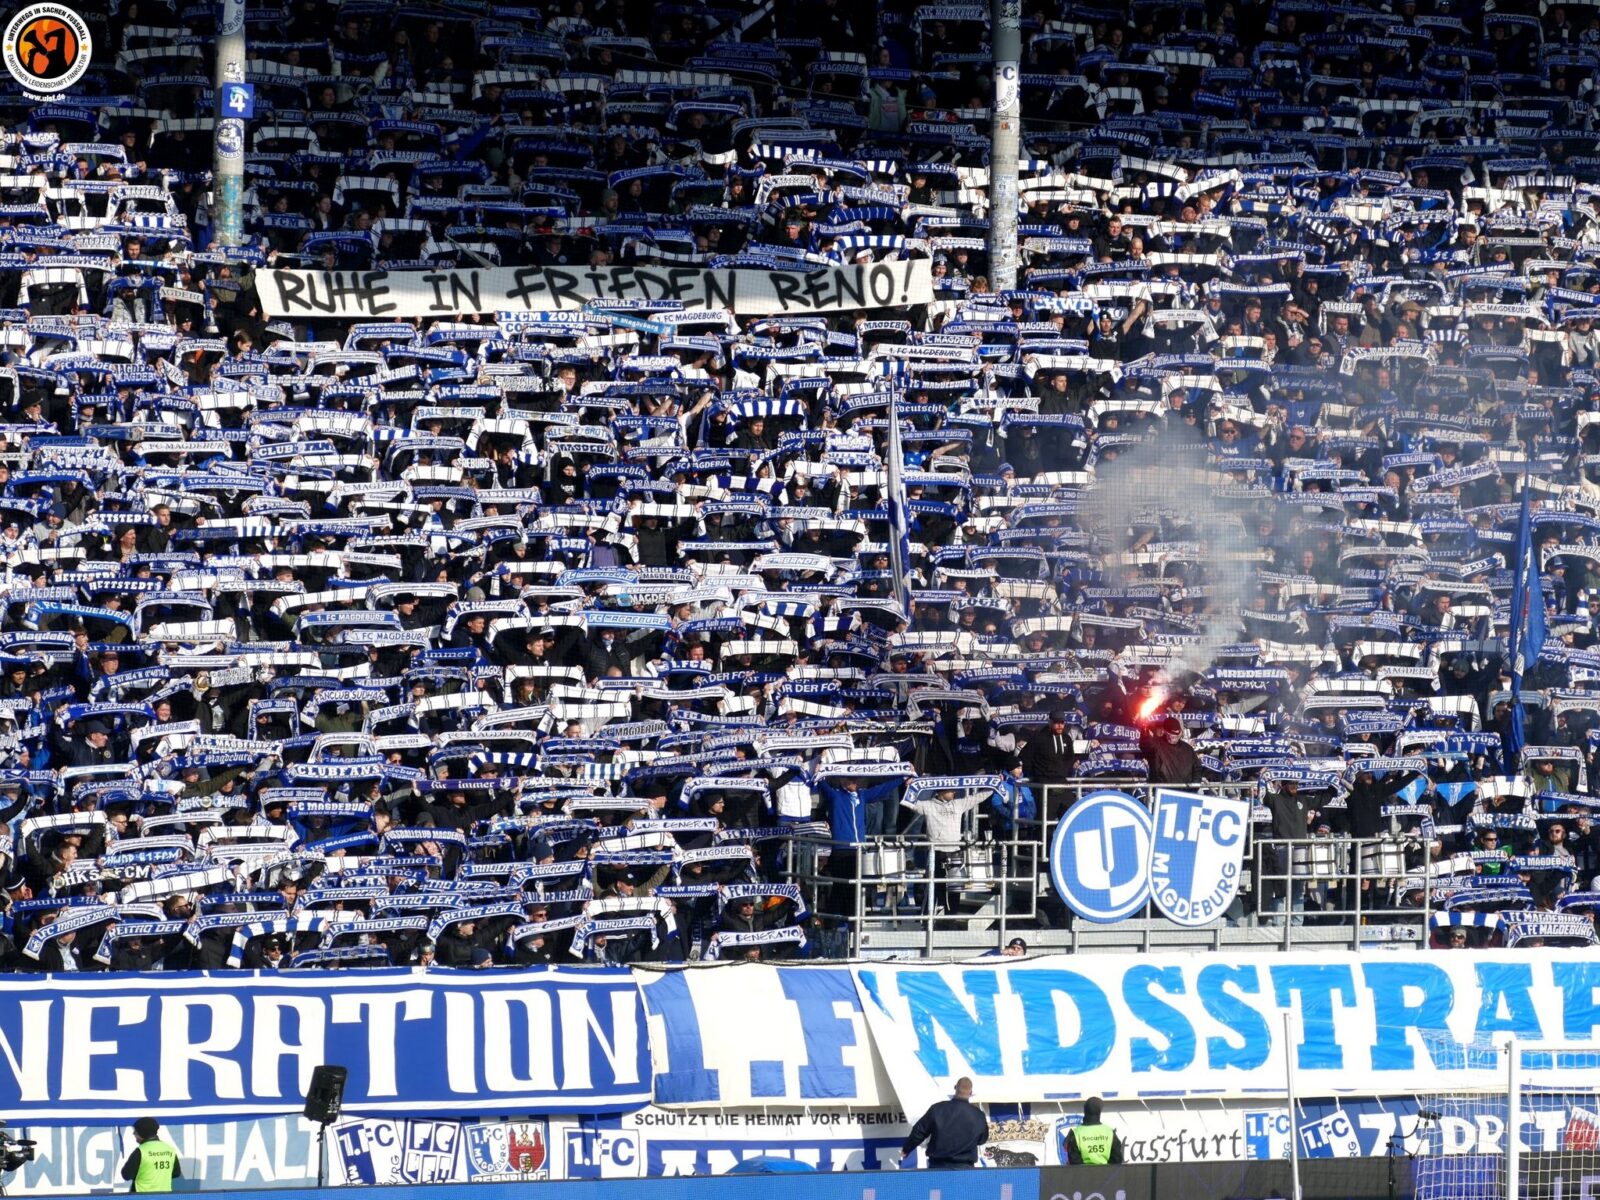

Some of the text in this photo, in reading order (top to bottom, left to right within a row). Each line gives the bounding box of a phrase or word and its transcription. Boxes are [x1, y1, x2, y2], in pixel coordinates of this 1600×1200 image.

[230, 94, 245, 112] 4
[34, 154, 55, 163] DER
[273, 270, 397, 316] RUHE
[422, 271, 482, 312] IN
[769, 261, 915, 310] RENO!
[500, 312, 542, 322] 1.FCM
[676, 312, 722, 321] MAGDEBURG
[910, 348, 961, 357] MAGDEBURG
[615, 417, 679, 430] Heinz Krügel
[259, 443, 295, 456] CLUB
[561, 539, 586, 548] DER
[90, 581, 152, 590] HETTSTEDT
[61, 603, 128, 620] MAGDEBURG
[604, 614, 667, 625] MAGDEBURG
[362, 633, 374, 641] FC
[424, 650, 472, 659] immer
[709, 672, 730, 681] DER
[795, 682, 818, 692] DER
[1028, 684, 1075, 694] immer
[1166, 713, 1210, 721] immer
[299, 765, 378, 776] CLUBFANS
[1306, 772, 1329, 781] DER
[431, 781, 447, 790] für
[912, 777, 960, 788] FREITAG
[963, 776, 987, 786] DER
[1472, 815, 1494, 824] HKS
[1160, 802, 1241, 848] 1.FC
[697, 847, 748, 857] MAGDEBURG
[64, 867, 149, 886] HKS FCM
[662, 885, 685, 893] crew
[729, 885, 741, 896] FC
[1152, 852, 1236, 921] MAGDEBURG
[224, 895, 279, 903] immer
[427, 896, 453, 906] DER
[438, 908, 477, 924] FREITAG
[478, 904, 509, 914] DER
[57, 908, 117, 932] MAGDEBURG
[156, 924, 182, 933] DER
[1527, 925, 1592, 936] FC MAGDEBURG
[635, 1109, 708, 1126] SCHÜTZT
[715, 1114, 740, 1127] DIE
[745, 1114, 803, 1127] HEIMAT
[811, 1113, 842, 1126] VOR
[1247, 1114, 1290, 1137] 1.FC
[472, 1128, 504, 1145] 1.FC
[1082, 1134, 1109, 1143] Security
[1304, 1118, 1349, 1150] 1.FC
[338, 1123, 395, 1157] 1.FC
[570, 1138, 635, 1166] 1.FC
[1087, 1145, 1105, 1154] 265
[147, 1151, 173, 1160] Security
[473, 1144, 507, 1173] MAGDEBURG
[153, 1160, 171, 1170] 183
